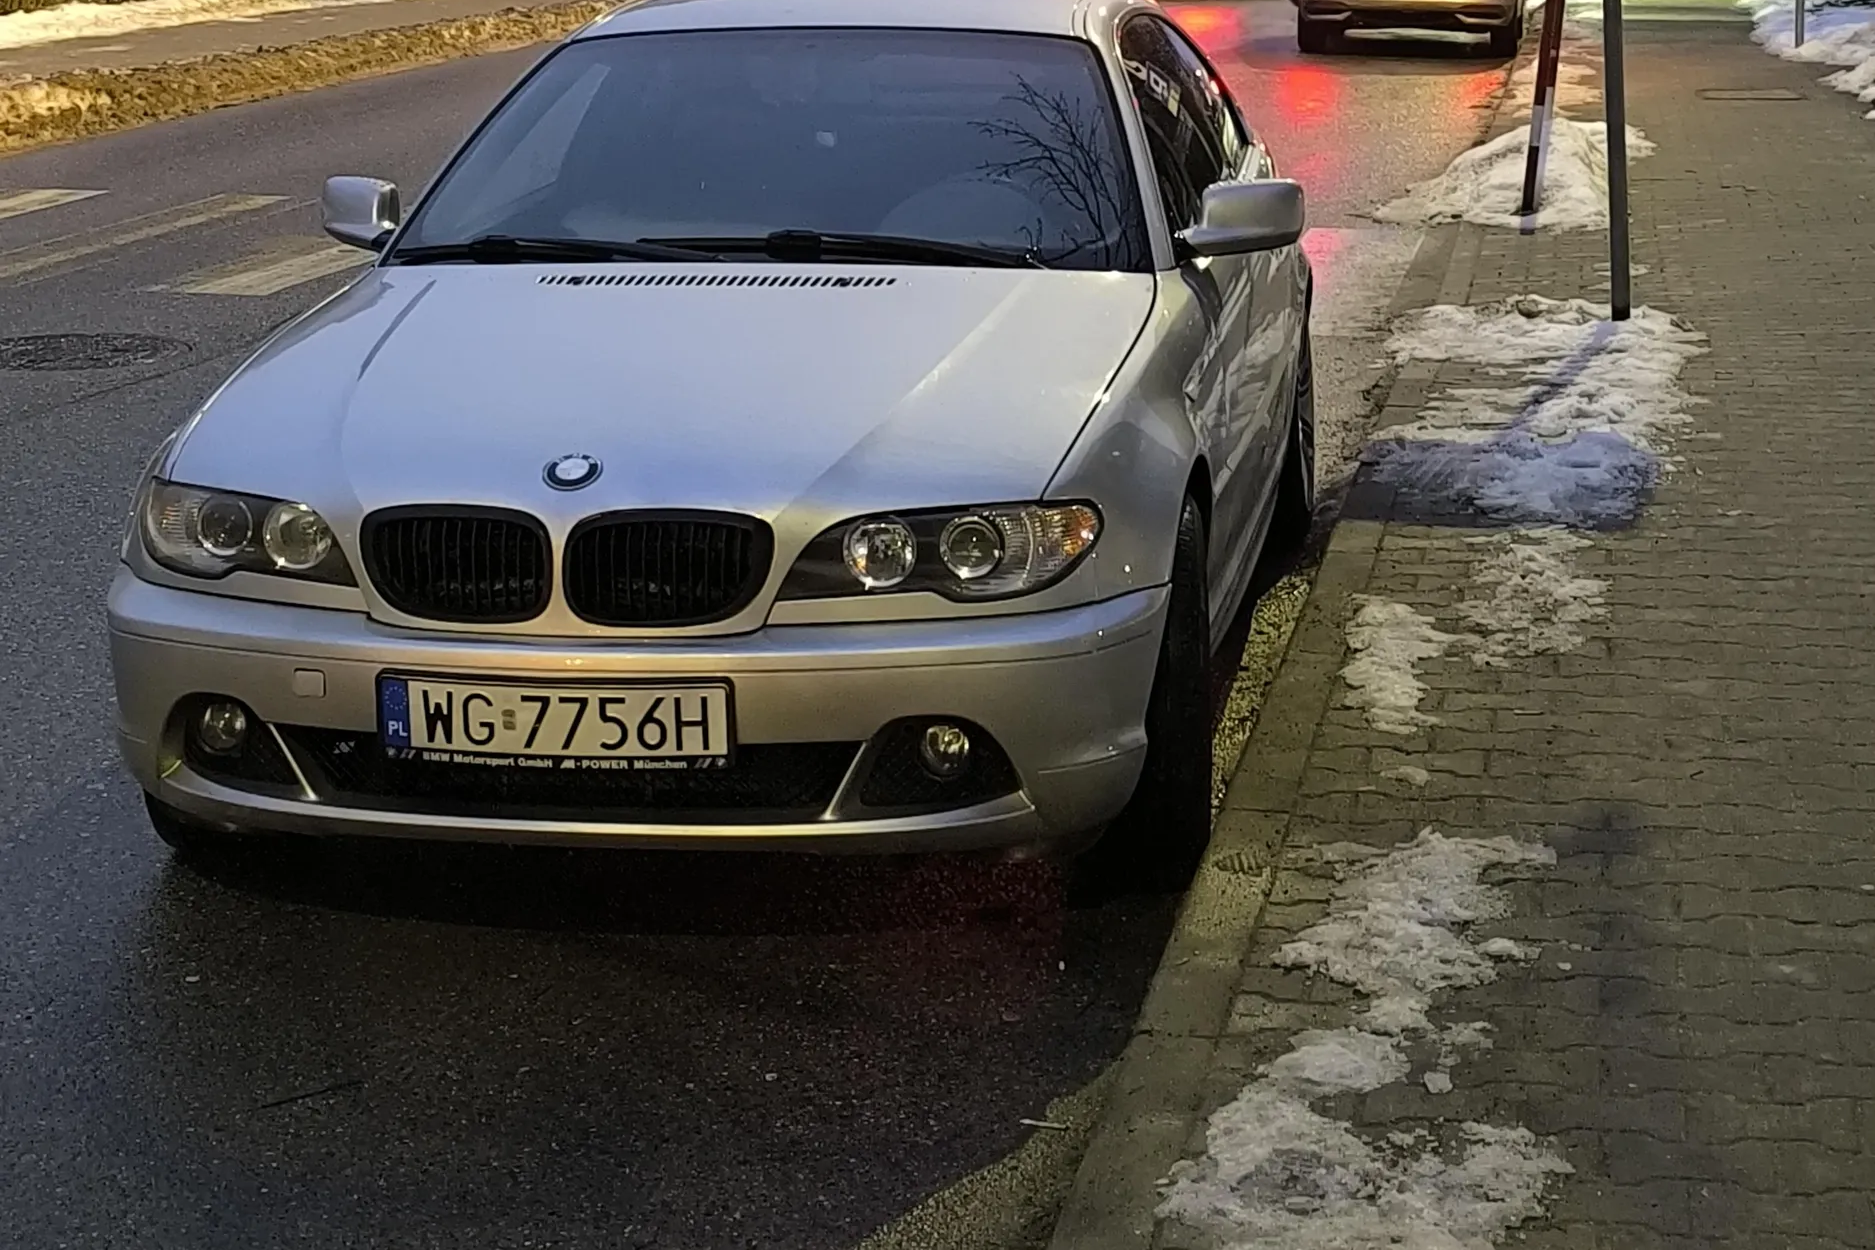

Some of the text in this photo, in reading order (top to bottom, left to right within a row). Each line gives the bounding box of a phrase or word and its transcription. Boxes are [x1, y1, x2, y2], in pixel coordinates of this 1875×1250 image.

[387, 720, 409, 737] PL
[421, 689, 711, 752] WG 7756H
[422, 750, 451, 762] BMW
[453, 752, 515, 767] Motorsport
[517, 757, 554, 769] GmbH
[633, 758, 689, 770] München
